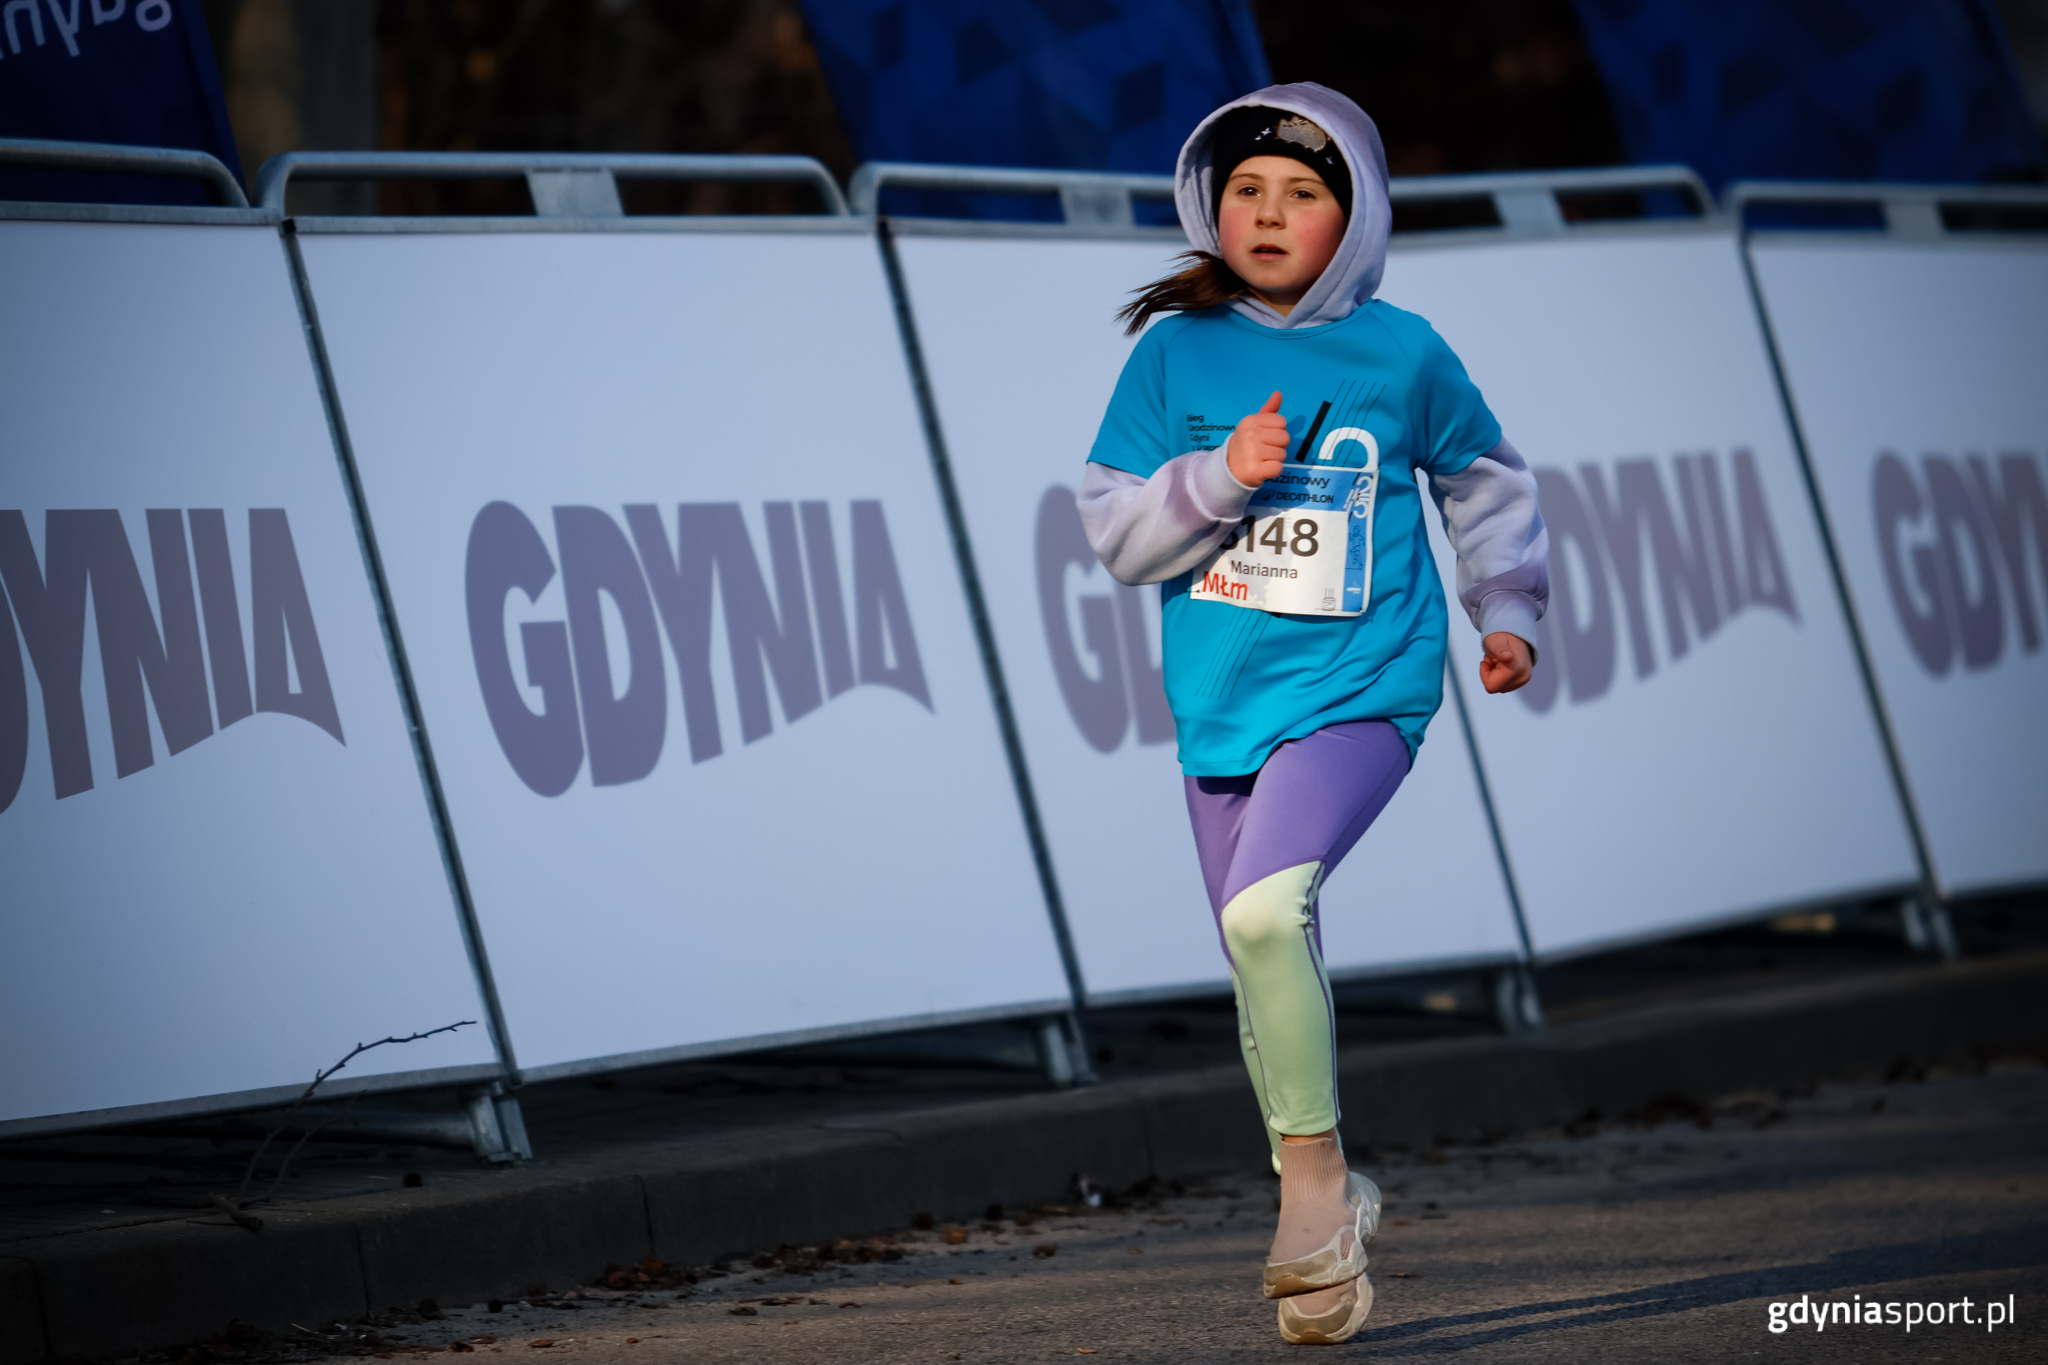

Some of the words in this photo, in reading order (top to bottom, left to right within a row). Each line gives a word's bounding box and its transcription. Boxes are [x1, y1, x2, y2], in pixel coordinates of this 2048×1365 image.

[1276, 491, 1335, 503] DECATHLON
[1231, 560, 1298, 579] Marianna
[1202, 571, 1248, 601] MŁm
[0, 507, 347, 815] YNIA
[465, 499, 936, 798] GDYNIA
